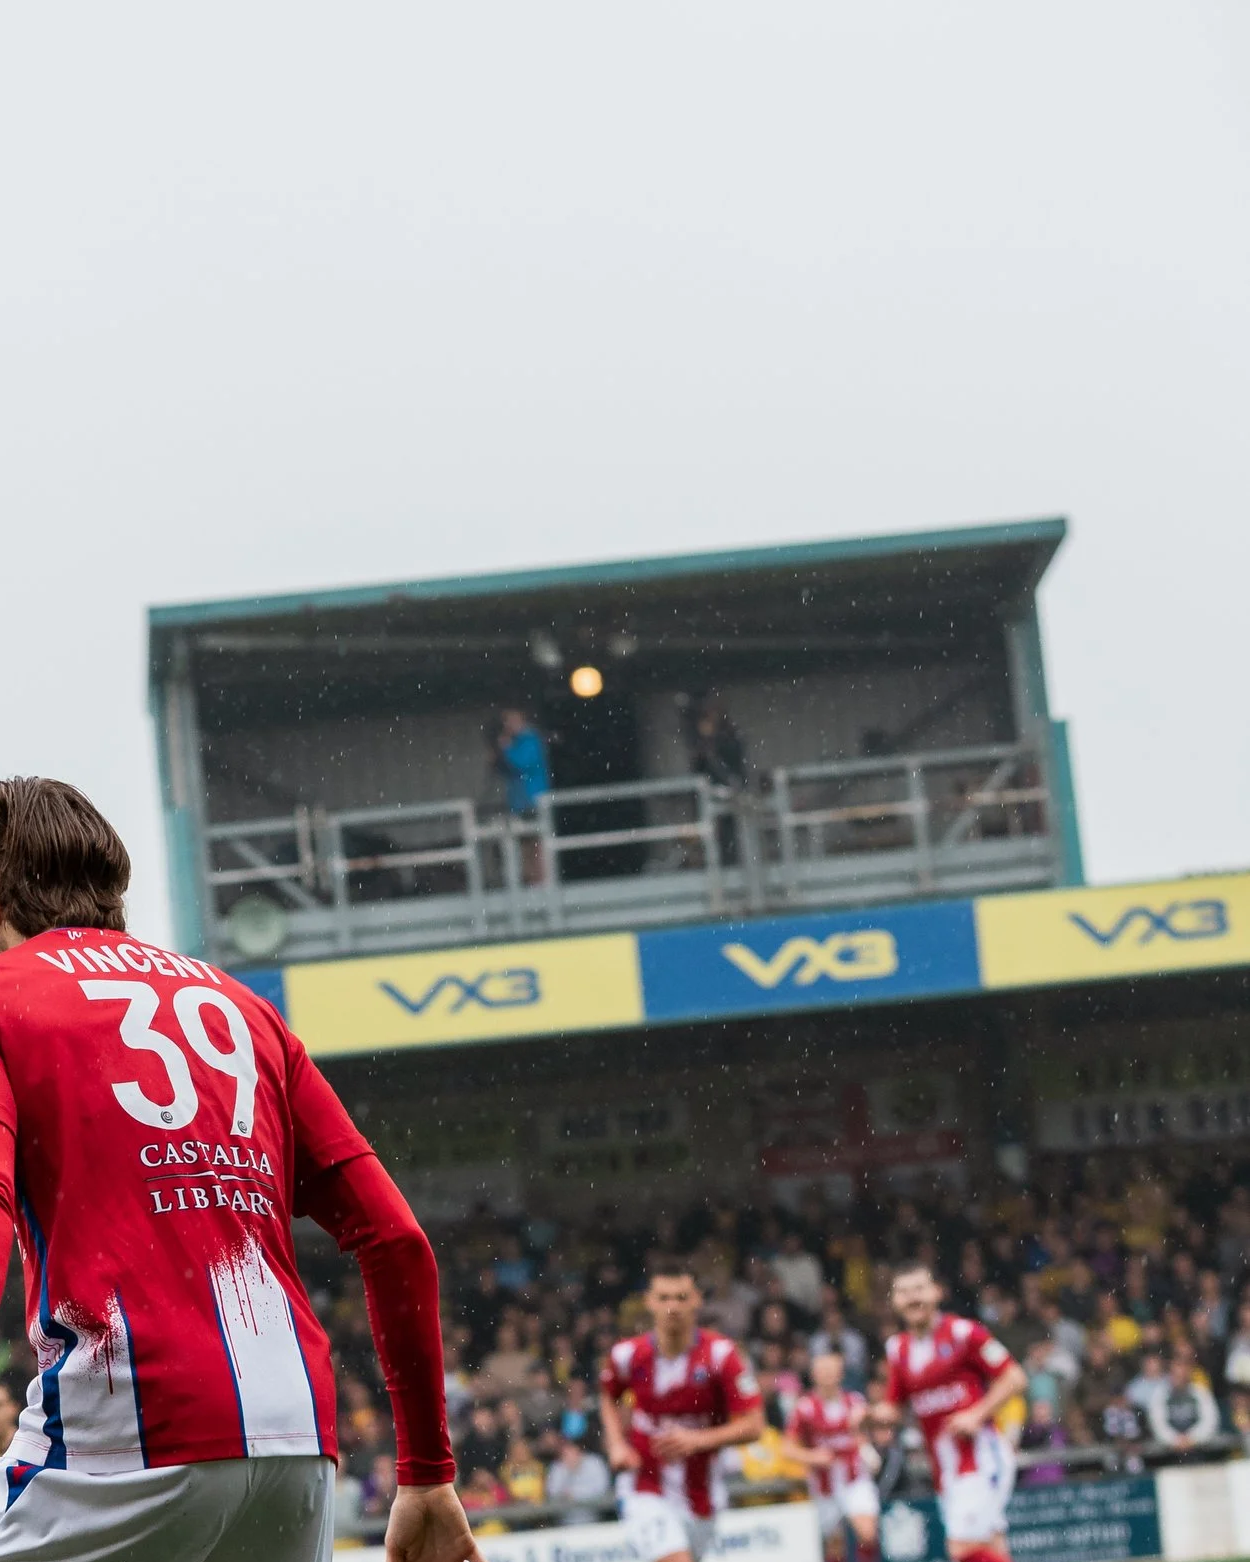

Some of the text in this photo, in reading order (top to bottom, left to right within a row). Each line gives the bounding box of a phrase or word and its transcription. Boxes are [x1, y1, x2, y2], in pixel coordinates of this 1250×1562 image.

[1067, 899, 1229, 948] VX3
[36, 944, 222, 985] VINCENT
[720, 931, 899, 989] VX3
[376, 968, 541, 1015] VX3
[78, 979, 258, 1139] 39
[140, 1141, 274, 1176] CASTALIA
[152, 1185, 277, 1220] LIBRARY
